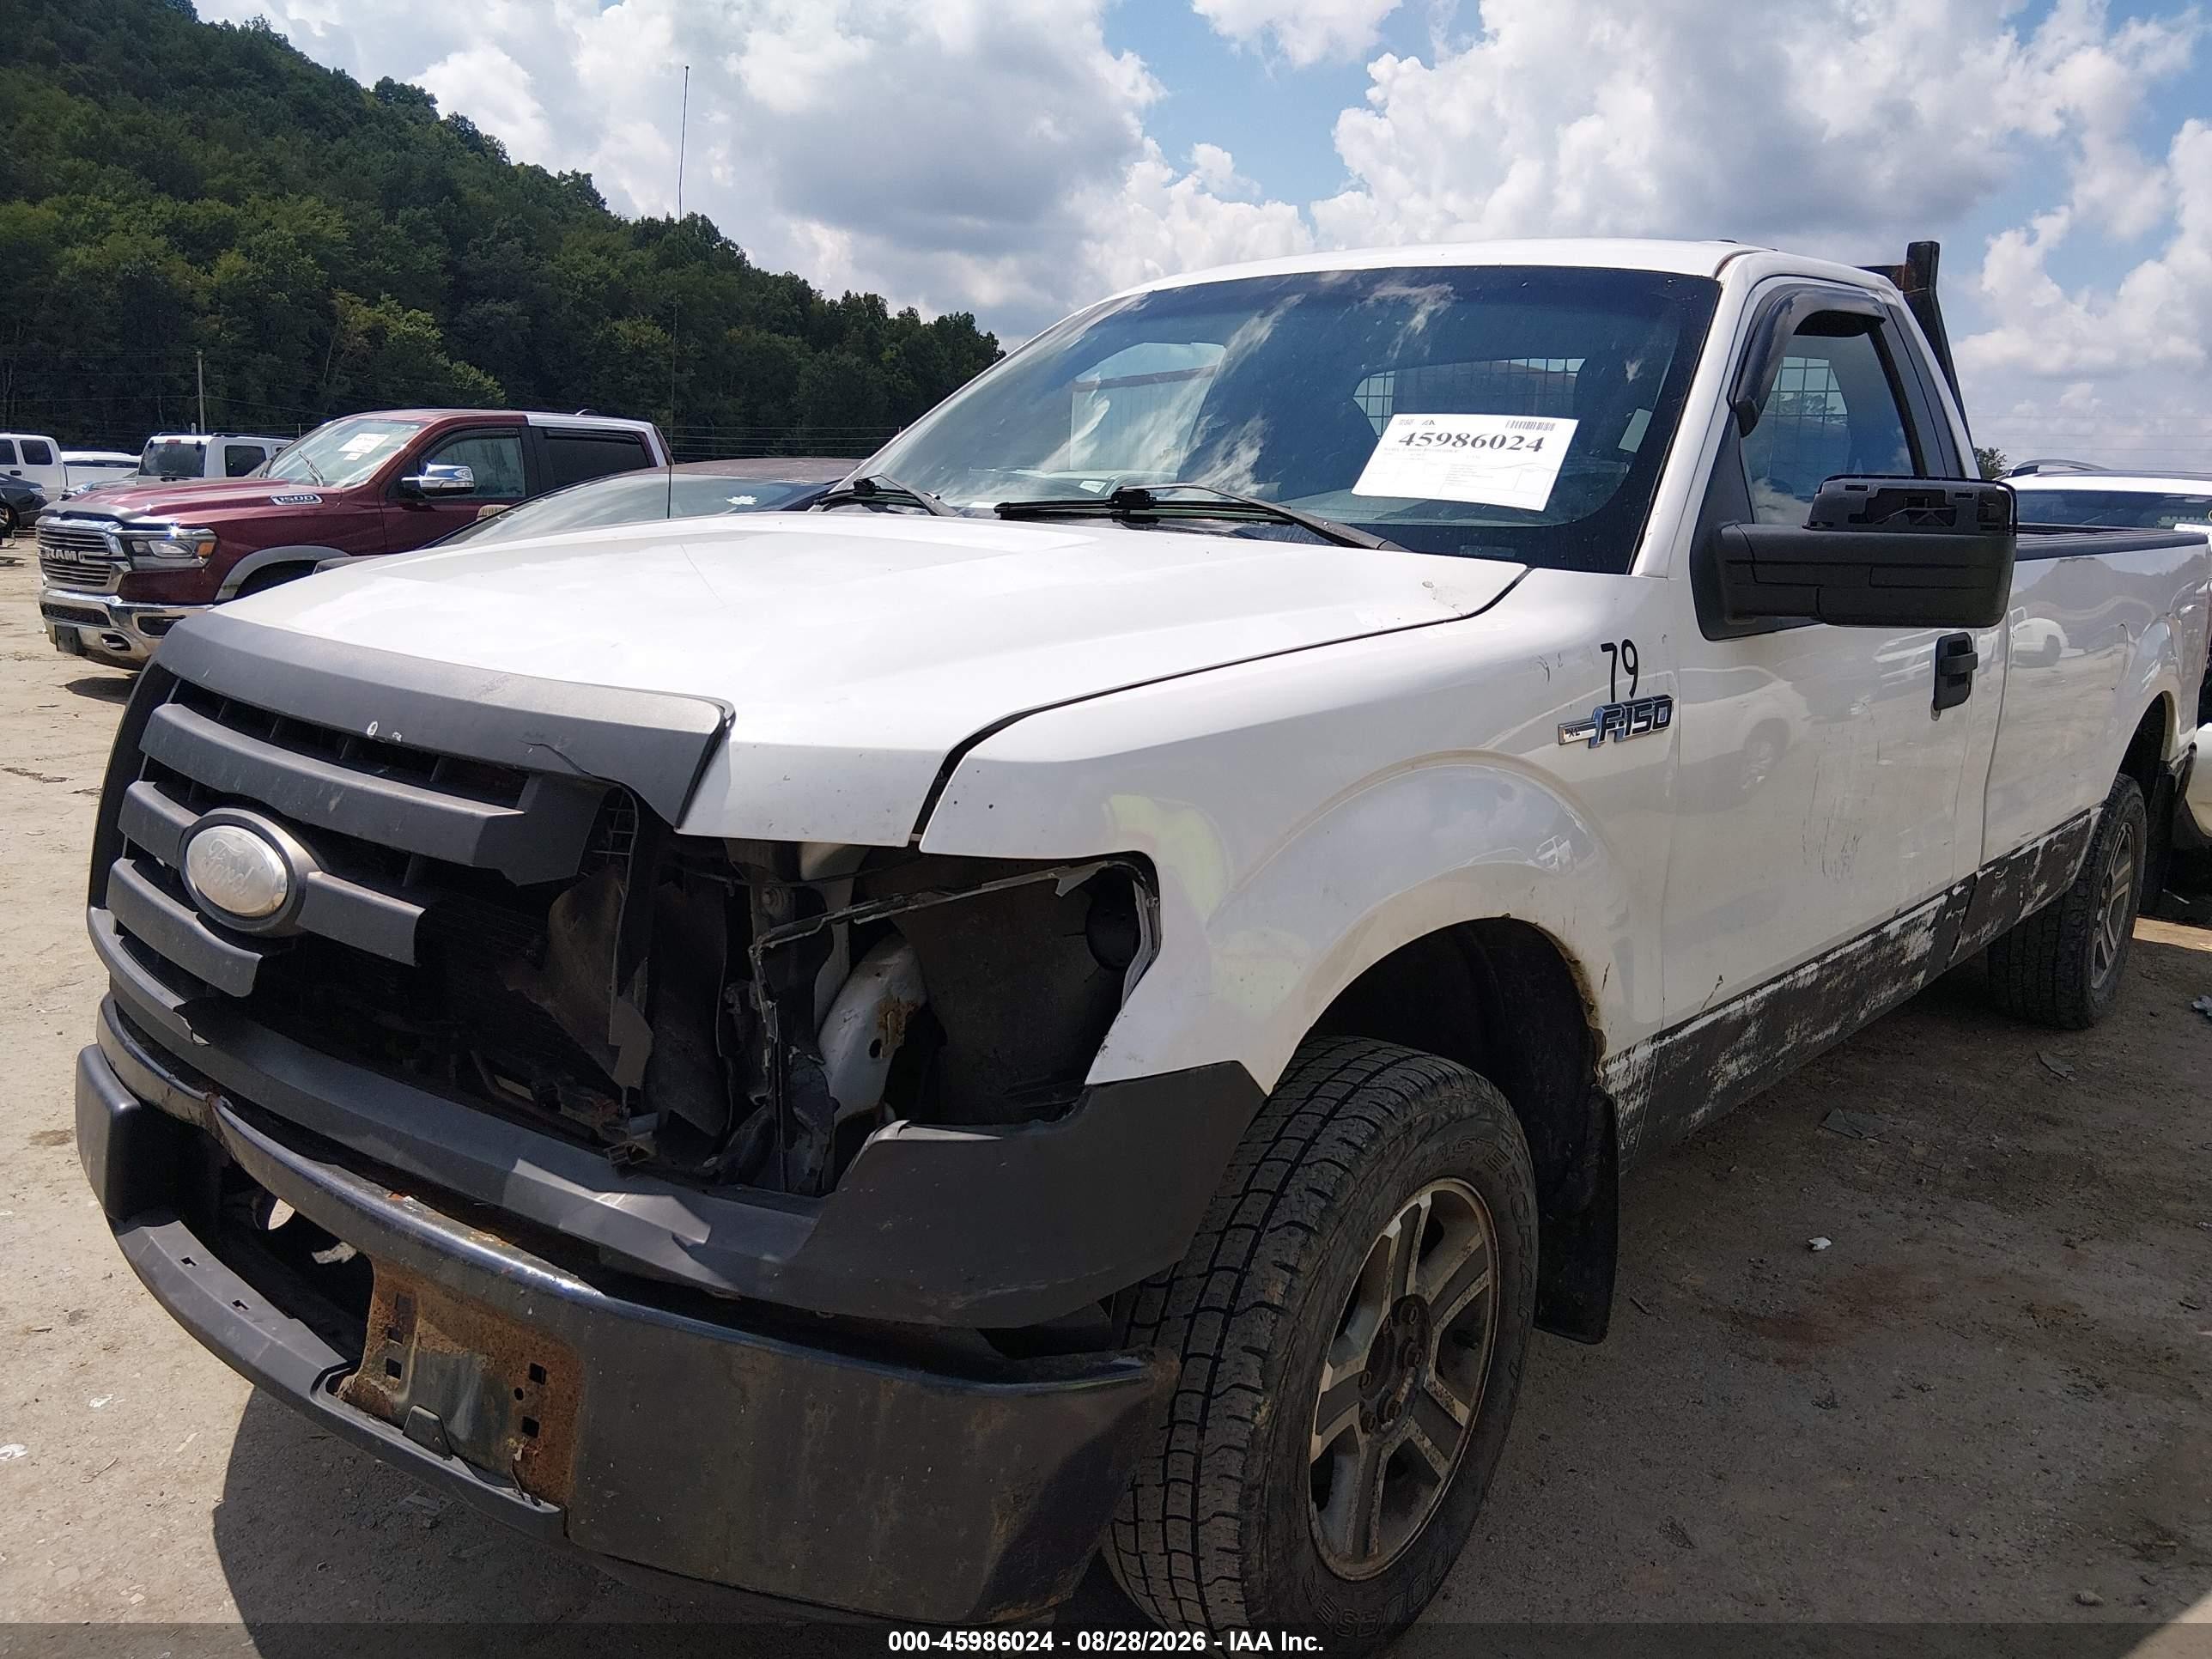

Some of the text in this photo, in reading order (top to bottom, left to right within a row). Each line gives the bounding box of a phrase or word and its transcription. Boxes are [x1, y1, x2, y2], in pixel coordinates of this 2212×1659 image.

[1398, 431, 1547, 453] 45986024
[275, 495, 315, 504] 1500
[40, 548, 78, 562] RAM
[1600, 638, 1639, 703] 79
[1568, 727, 1581, 738] XL
